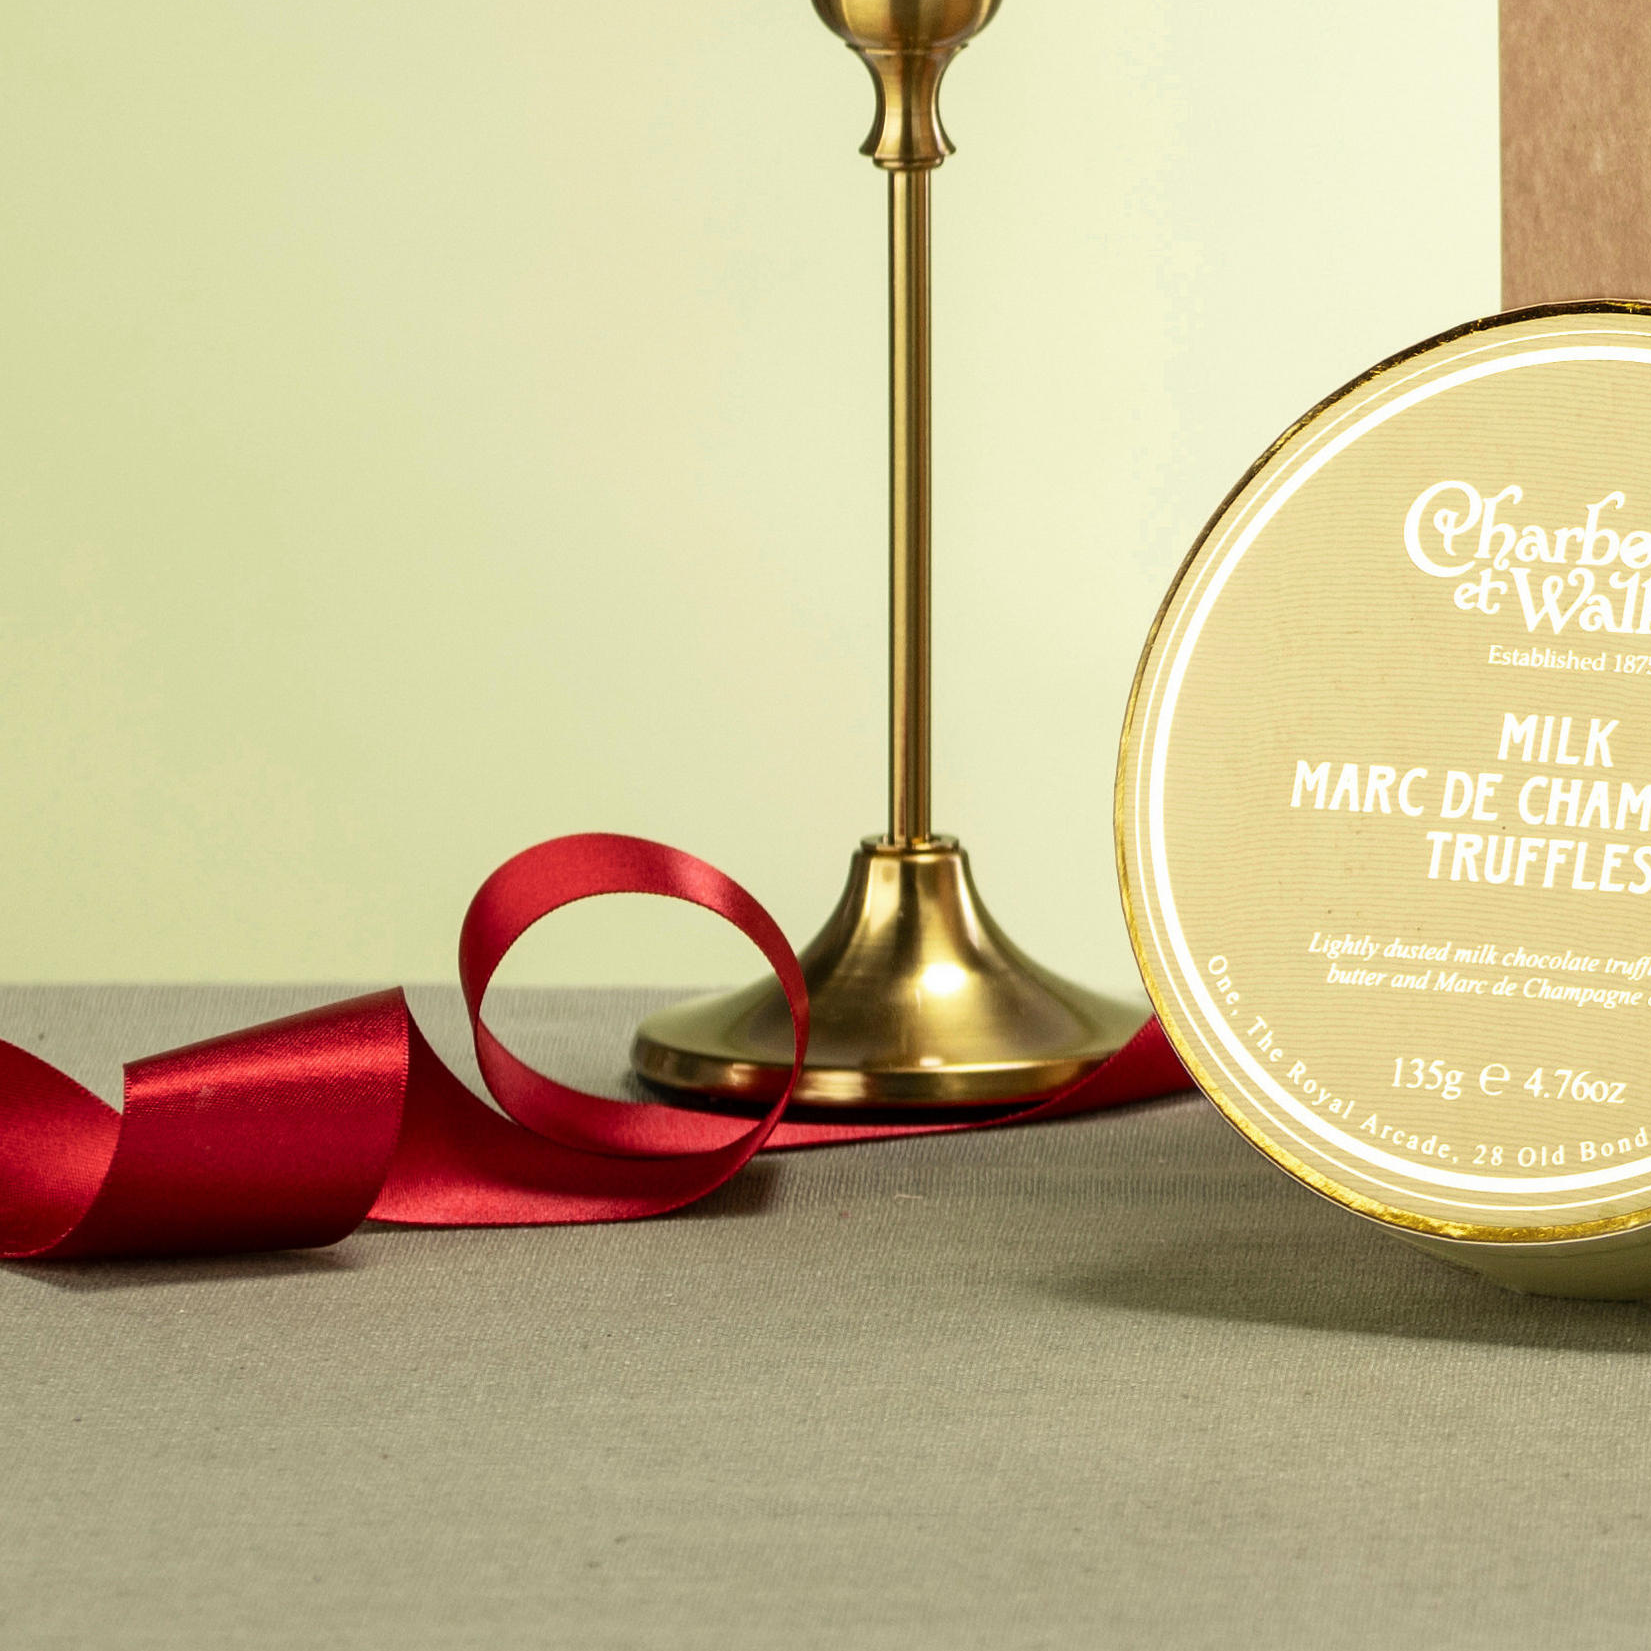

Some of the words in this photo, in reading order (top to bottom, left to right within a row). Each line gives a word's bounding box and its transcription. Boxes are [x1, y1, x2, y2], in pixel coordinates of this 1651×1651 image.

[1454, 569, 1508, 614] et
[1488, 645, 1606, 671] Established
[1497, 712, 1620, 768] MILK
[1290, 760, 1428, 817] MARC
[1439, 770, 1503, 821] DE
[1308, 932, 1380, 961] Lightly
[1383, 938, 1451, 961] dusted
[1453, 944, 1498, 965] milk
[1502, 947, 1600, 972] chocolate
[1326, 963, 1388, 986] butter
[1391, 970, 1431, 990] and
[1433, 972, 1488, 994] Marc
[1492, 976, 1518, 996] de
[1523, 978, 1643, 1009] Champagne
[1208, 955, 1240, 1016] One,
[1247, 1016, 1283, 1062] The
[1287, 1060, 1355, 1120] Royal
[1360, 1113, 1459, 1163] Arcade,
[1472, 1144, 1503, 1166] 28
[1518, 1146, 1565, 1167] Old
[1580, 1129, 1650, 1162] Bond
[1392, 1058, 1464, 1099] 135g
[1524, 1067, 1626, 1104] 4.76oz
